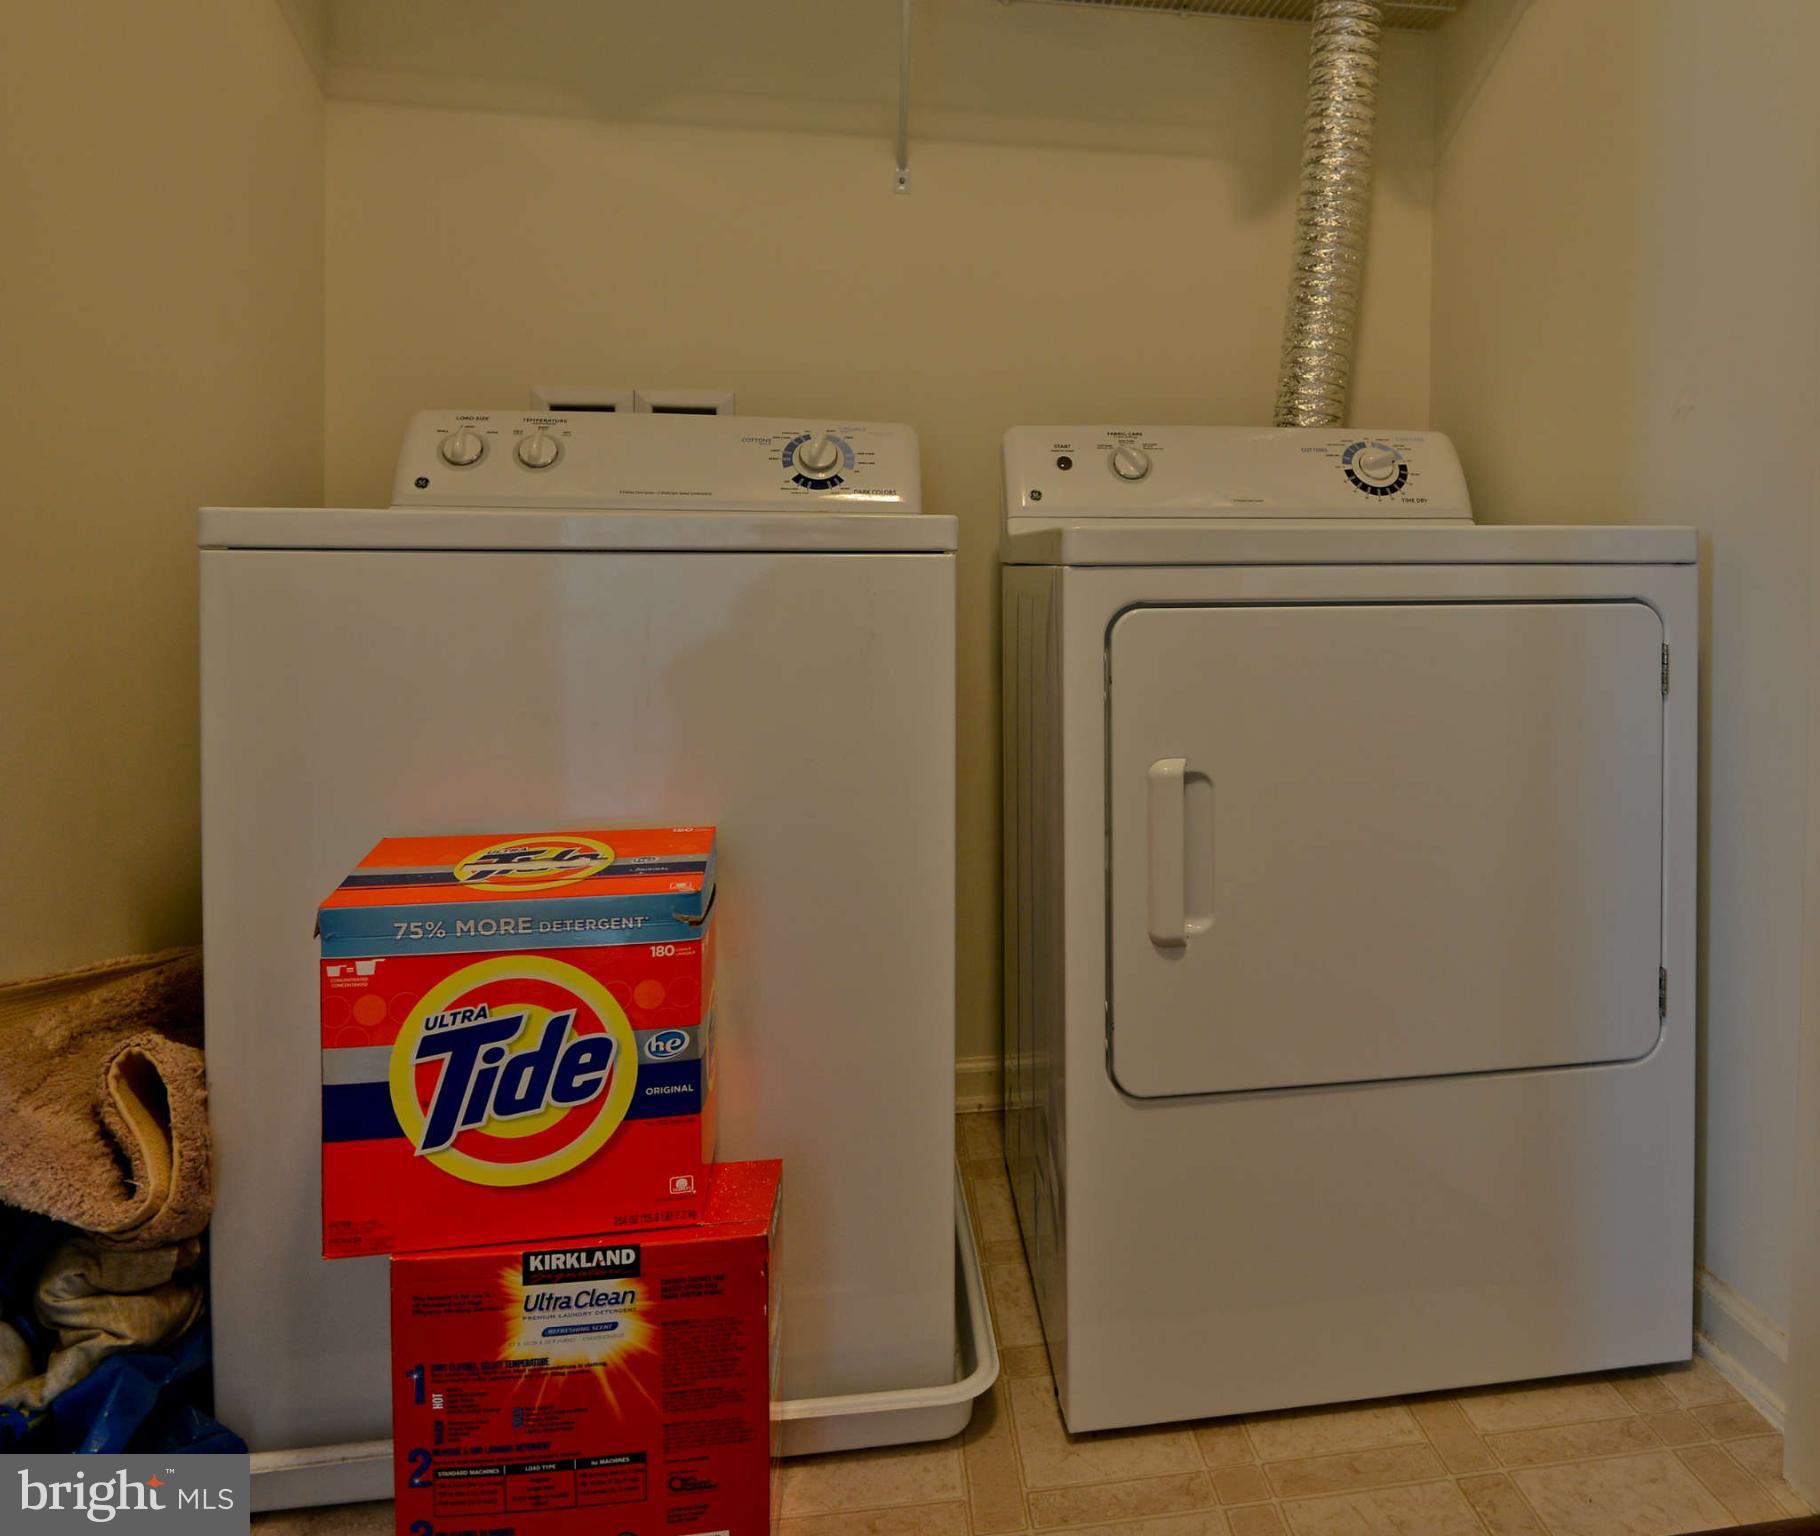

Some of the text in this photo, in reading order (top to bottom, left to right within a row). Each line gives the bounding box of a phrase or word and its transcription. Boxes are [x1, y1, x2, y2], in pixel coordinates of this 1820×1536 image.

[392, 920, 446, 940] 75%
[456, 916, 533, 937] MORE
[650, 944, 675, 958] 180
[425, 1006, 488, 1031] ULTRA
[415, 1013, 614, 1150] Tide
[645, 1084, 694, 1096] ORIGINAL
[529, 1248, 636, 1272] KIRKLAND
[524, 1293, 572, 1313] Ultra
[574, 1289, 636, 1309] Clean
[595, 1307, 638, 1316] DETERGENT
[546, 1326, 591, 1335] REFRESHING
[405, 1364, 425, 1405] 1
[432, 1394, 444, 1409] HOT
[408, 1448, 433, 1488] 2
[524, 1464, 542, 1472] LOAD
[600, 1456, 631, 1465] MACHINES
[437, 1468, 500, 1478] STANDARD MACHINES
